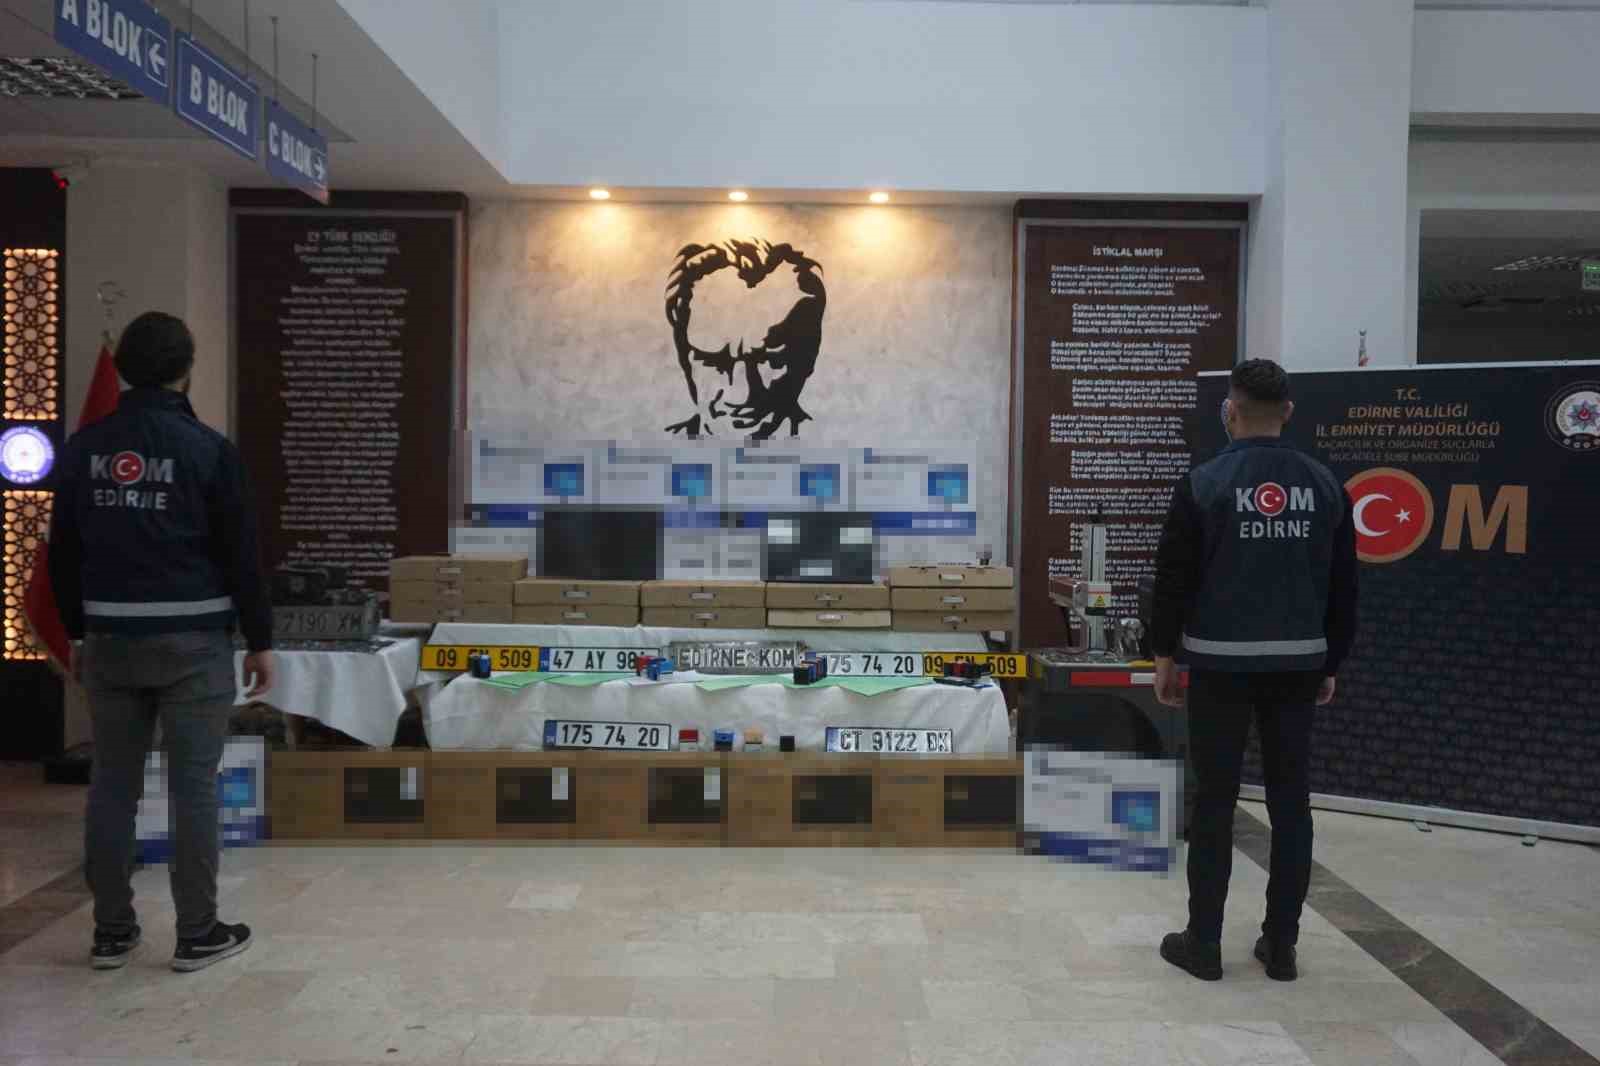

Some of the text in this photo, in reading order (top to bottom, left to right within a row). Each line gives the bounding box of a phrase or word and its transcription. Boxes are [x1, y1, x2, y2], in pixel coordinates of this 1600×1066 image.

[61, 0, 143, 67] A BLOK
[190, 64, 248, 135] B BLOK
[269, 120, 312, 180] C BLOK
[1395, 387, 1421, 400] T.C.
[1347, 404, 1401, 418] EDİRNE
[1330, 421, 1395, 437] EMNİYET
[1397, 420, 1501, 437] MÜDÜRLÜĞÜ
[1240, 517, 1311, 540] EDİRNE
[436, 648, 532, 669] 09 509
[553, 650, 646, 671] 47 AY 98
[759, 647, 796, 669] KOM
[861, 654, 883, 674] 74
[893, 654, 914, 674] 20
[924, 655, 944, 674] 09
[562, 723, 593, 745] 175
[604, 725, 626, 747] 74
[637, 727, 660, 748] 20
[840, 731, 863, 751] CT
[872, 731, 917, 752] 9122
